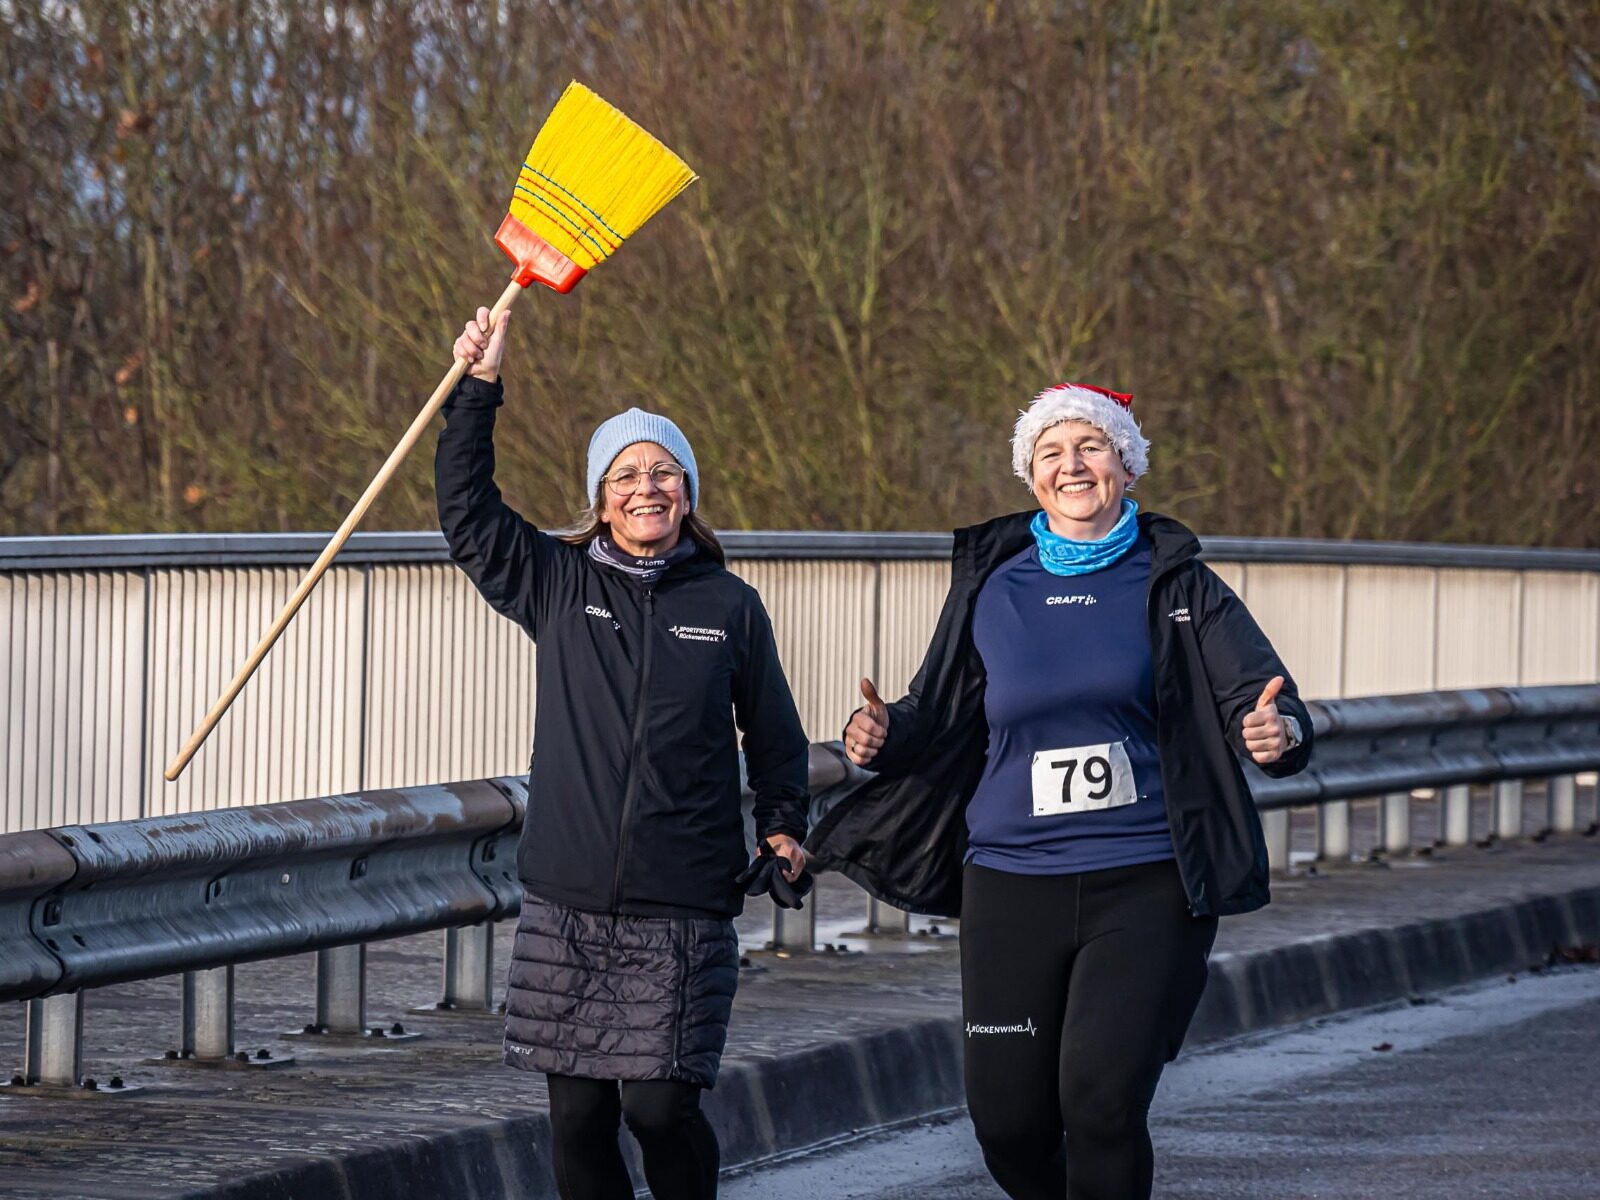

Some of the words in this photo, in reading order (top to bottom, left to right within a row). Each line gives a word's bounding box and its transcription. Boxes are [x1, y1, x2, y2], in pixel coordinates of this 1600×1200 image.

[1046, 595, 1085, 605] CRAFT
[585, 605, 612, 618] CRAF
[1050, 755, 1113, 804] 79
[971, 1024, 1023, 1034] RÜCKENWIND
